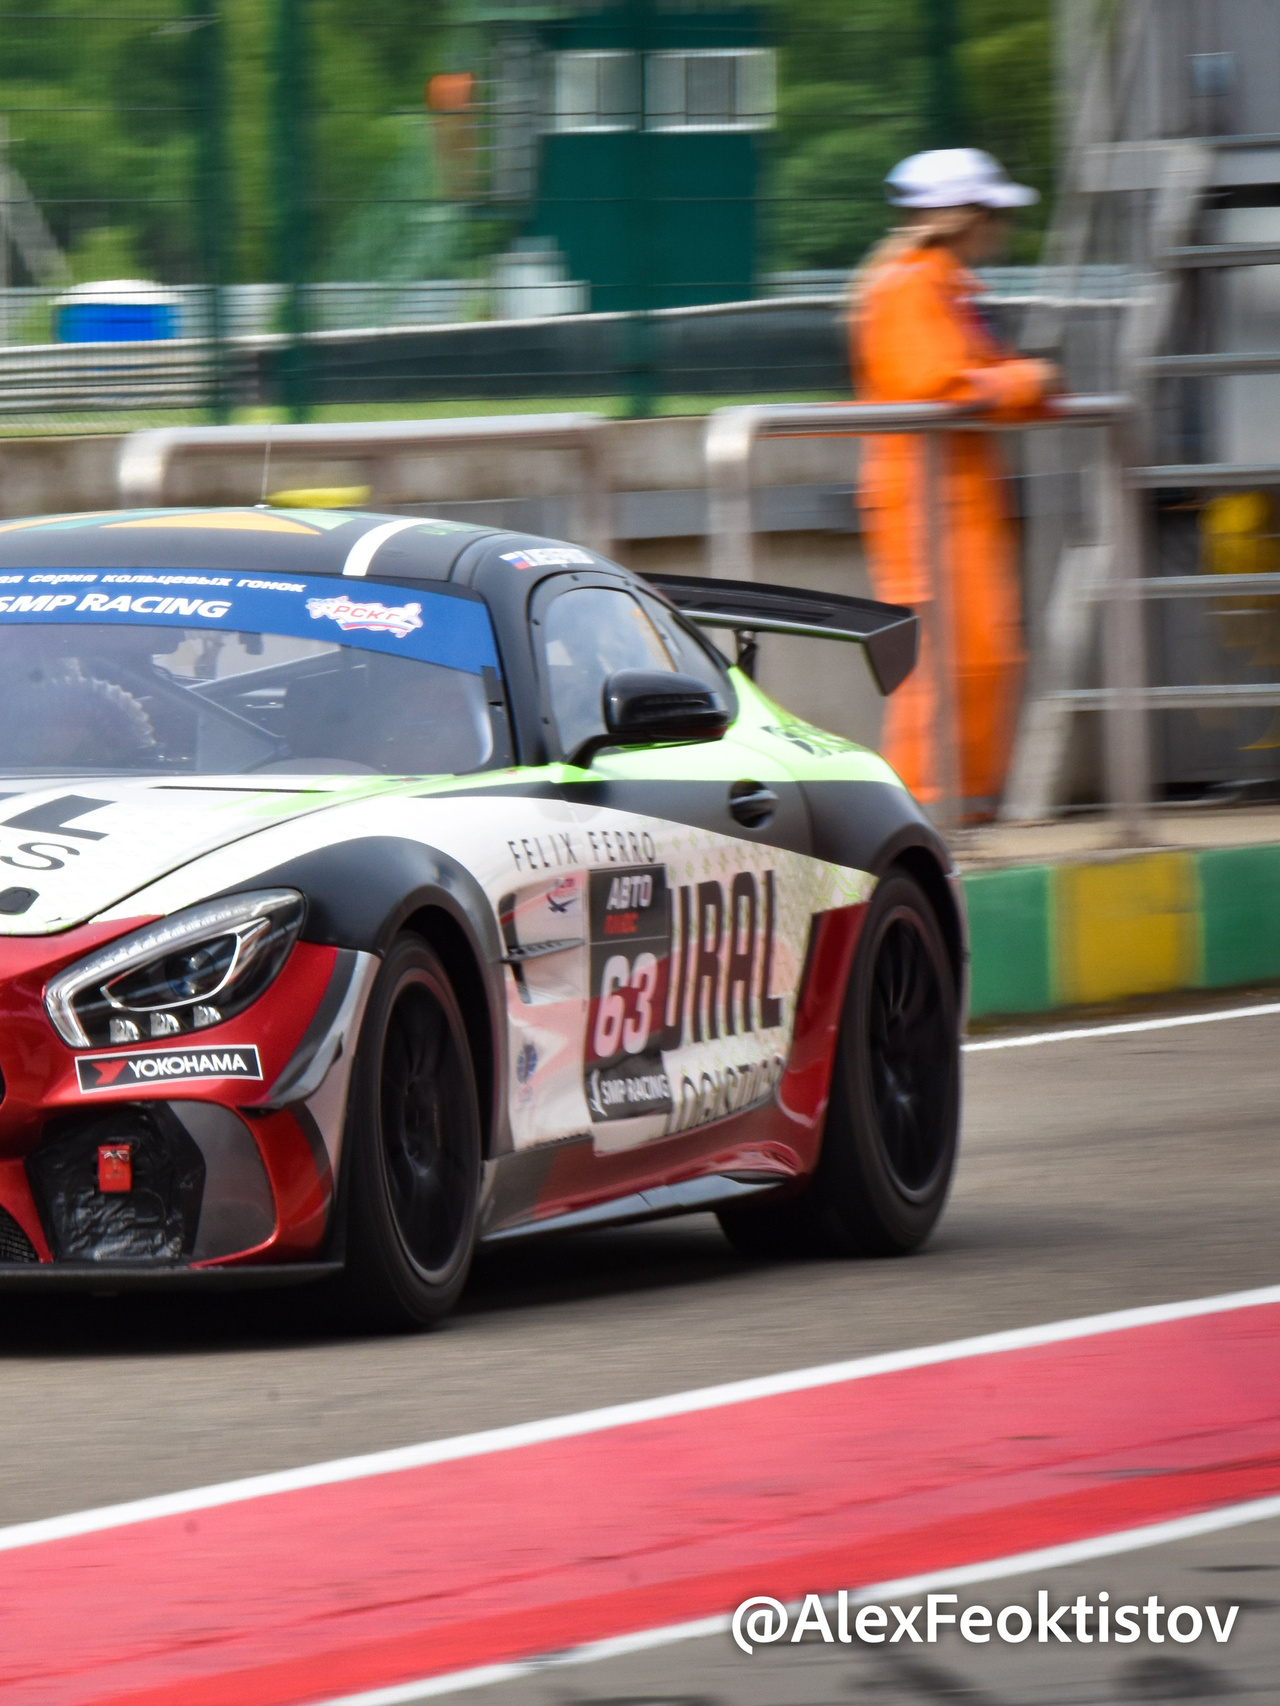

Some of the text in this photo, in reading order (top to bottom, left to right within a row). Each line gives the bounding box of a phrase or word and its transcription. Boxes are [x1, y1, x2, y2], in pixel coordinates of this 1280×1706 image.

[27, 572, 96, 586] серия
[101, 573, 234, 588] кольцевых
[236, 579, 307, 593] гонок
[75, 593, 233, 619] RACING
[507, 830, 657, 872] FELIX FERRO
[594, 951, 658, 1059] 63
[128, 1053, 248, 1079] YOKOHAMA
[600, 1074, 671, 1106] SMP RACING
